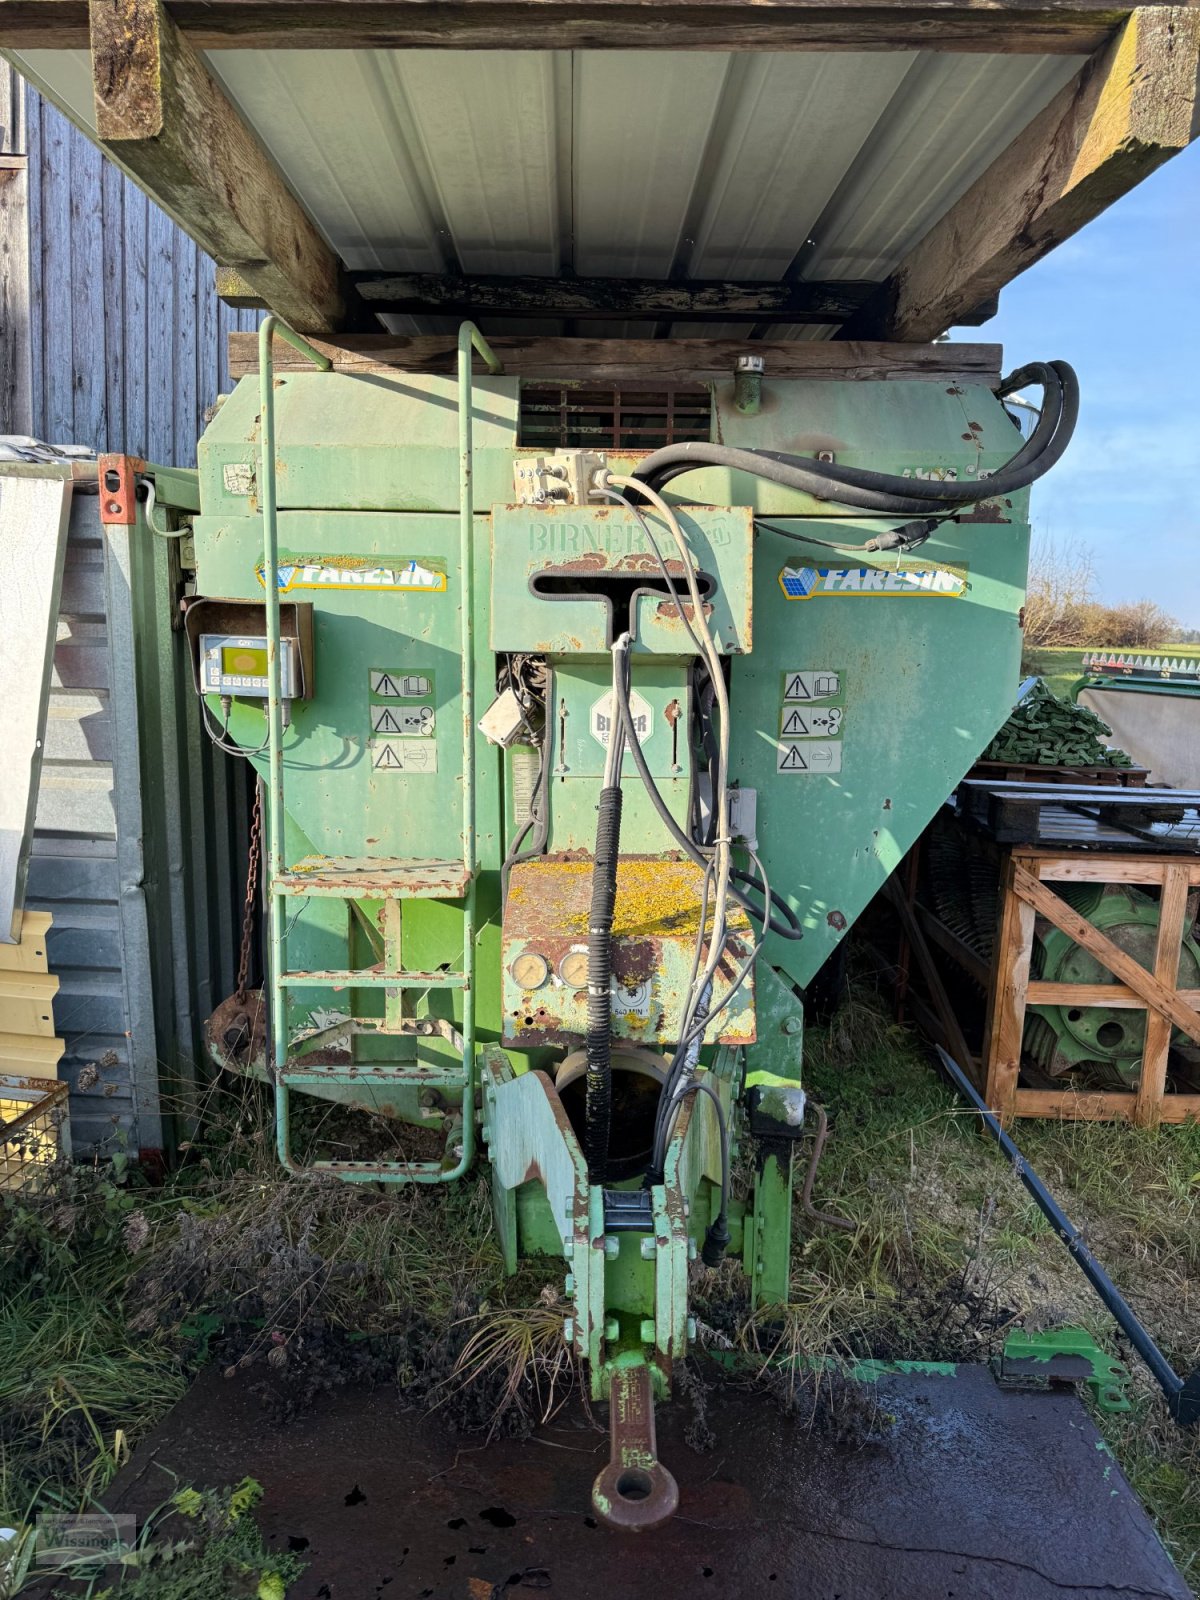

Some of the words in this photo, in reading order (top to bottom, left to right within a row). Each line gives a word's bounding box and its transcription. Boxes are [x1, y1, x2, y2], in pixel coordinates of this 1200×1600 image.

[529, 522, 647, 553] BIRNER
[824, 569, 957, 591] FARESIN
[596, 713, 647, 732] BIER
[614, 1008, 628, 1016] 540
